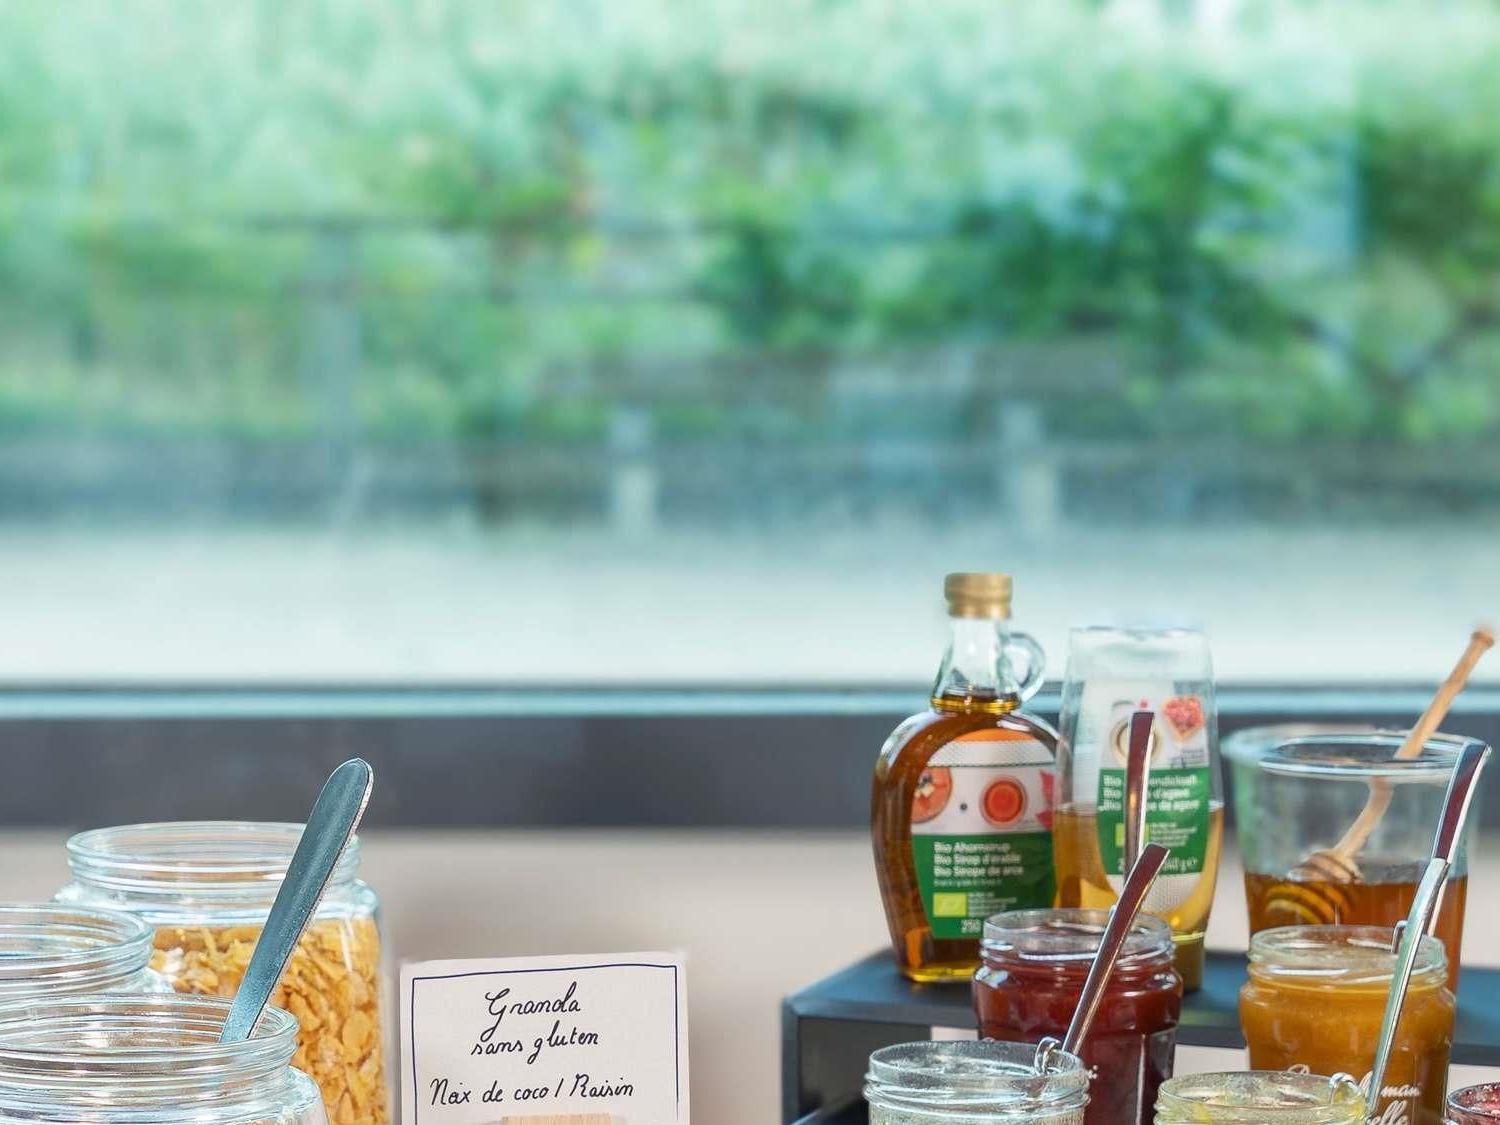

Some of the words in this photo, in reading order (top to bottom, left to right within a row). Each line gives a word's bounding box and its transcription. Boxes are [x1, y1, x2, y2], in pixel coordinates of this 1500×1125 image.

[934, 842, 952, 854] Bio
[934, 854, 952, 865] Bio
[954, 854, 981, 866] Sirop
[934, 866, 952, 877] Bio
[480, 981, 581, 1043] Granola
[470, 1039, 525, 1056] sans
[527, 1020, 599, 1065] gluten
[482, 1080, 504, 1103] de
[514, 1087, 549, 1100] coco
[569, 1073, 634, 1098] Raisin
